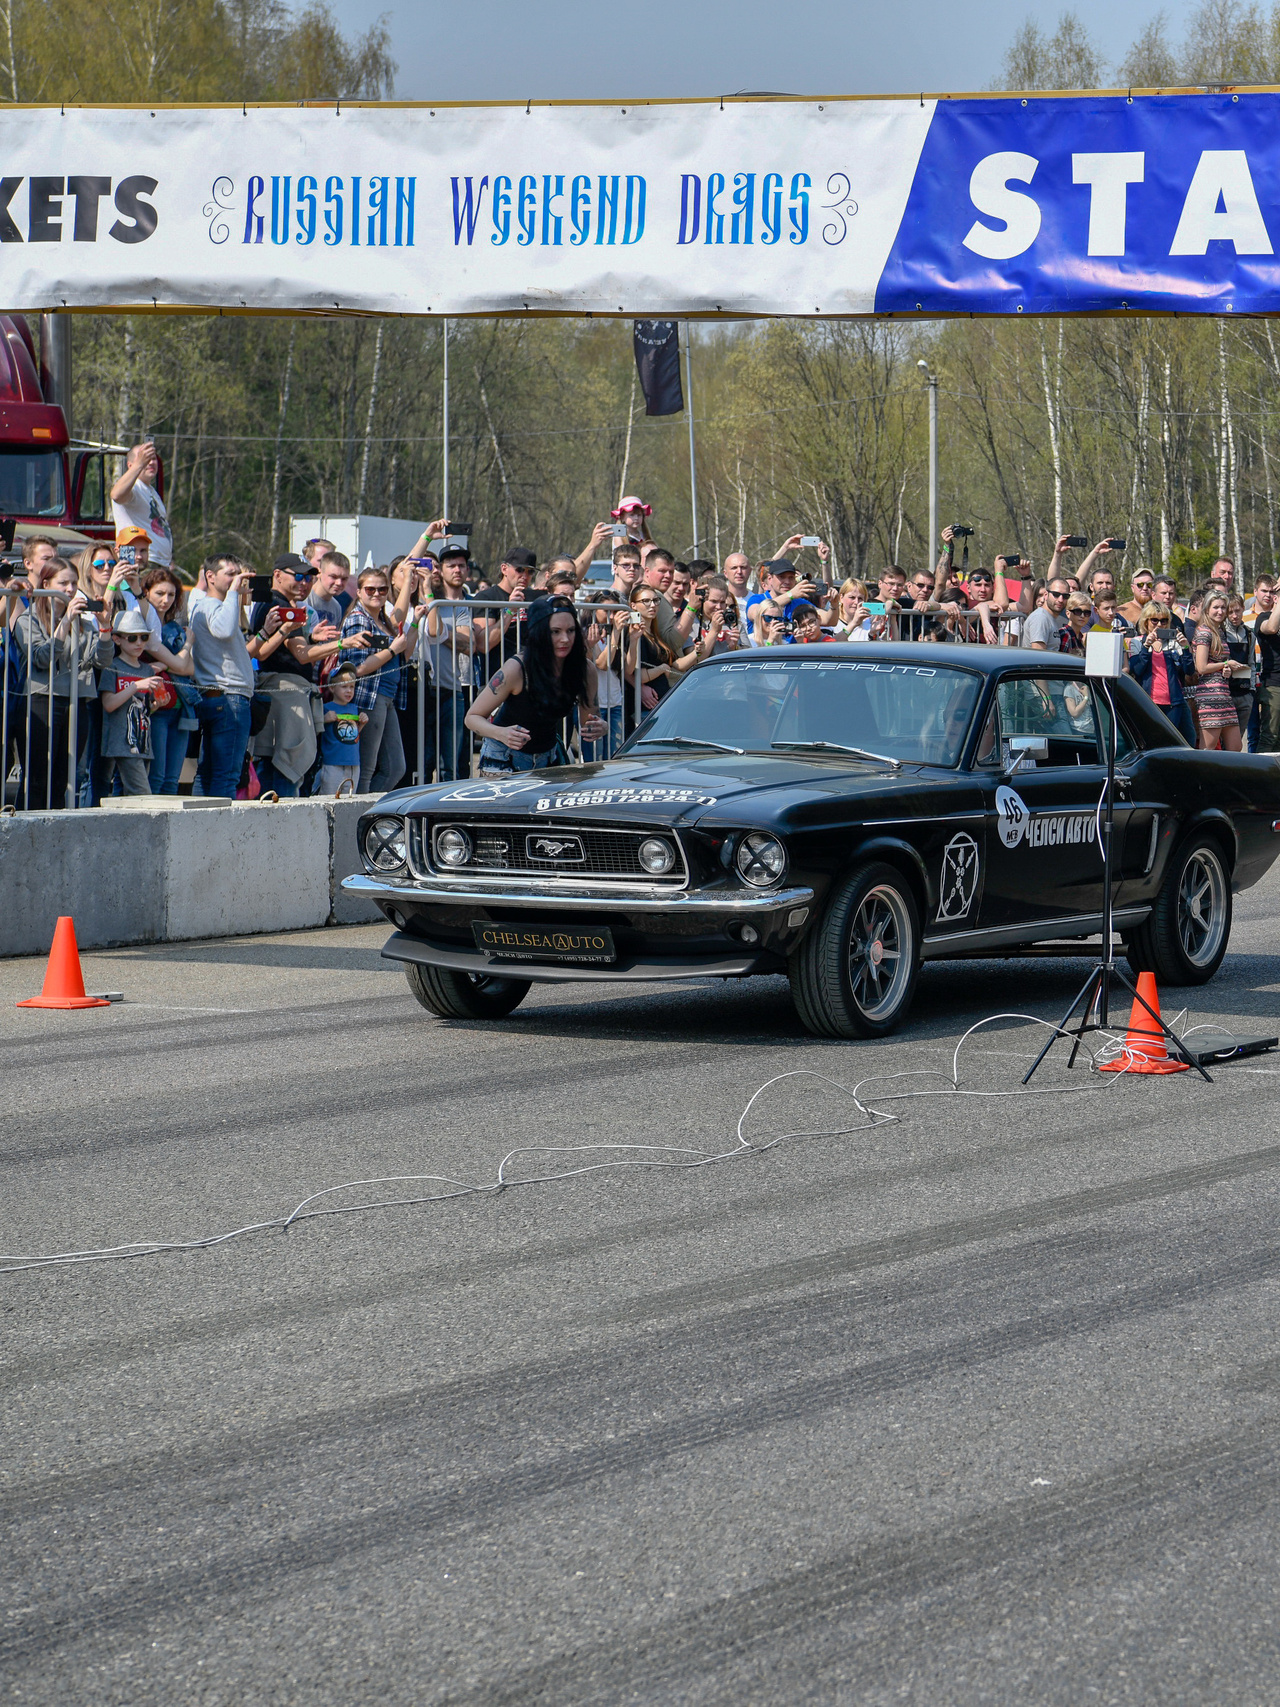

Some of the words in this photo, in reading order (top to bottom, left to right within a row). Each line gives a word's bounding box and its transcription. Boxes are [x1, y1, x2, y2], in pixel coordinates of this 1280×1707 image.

[243, 175, 417, 247] RUSSIAN
[450, 174, 647, 247] WEEKEND
[676, 172, 812, 246] DRAGS
[720, 662, 937, 677] #CHELSEAAUTO
[536, 798, 550, 811] 8
[1003, 796, 1023, 825] 46
